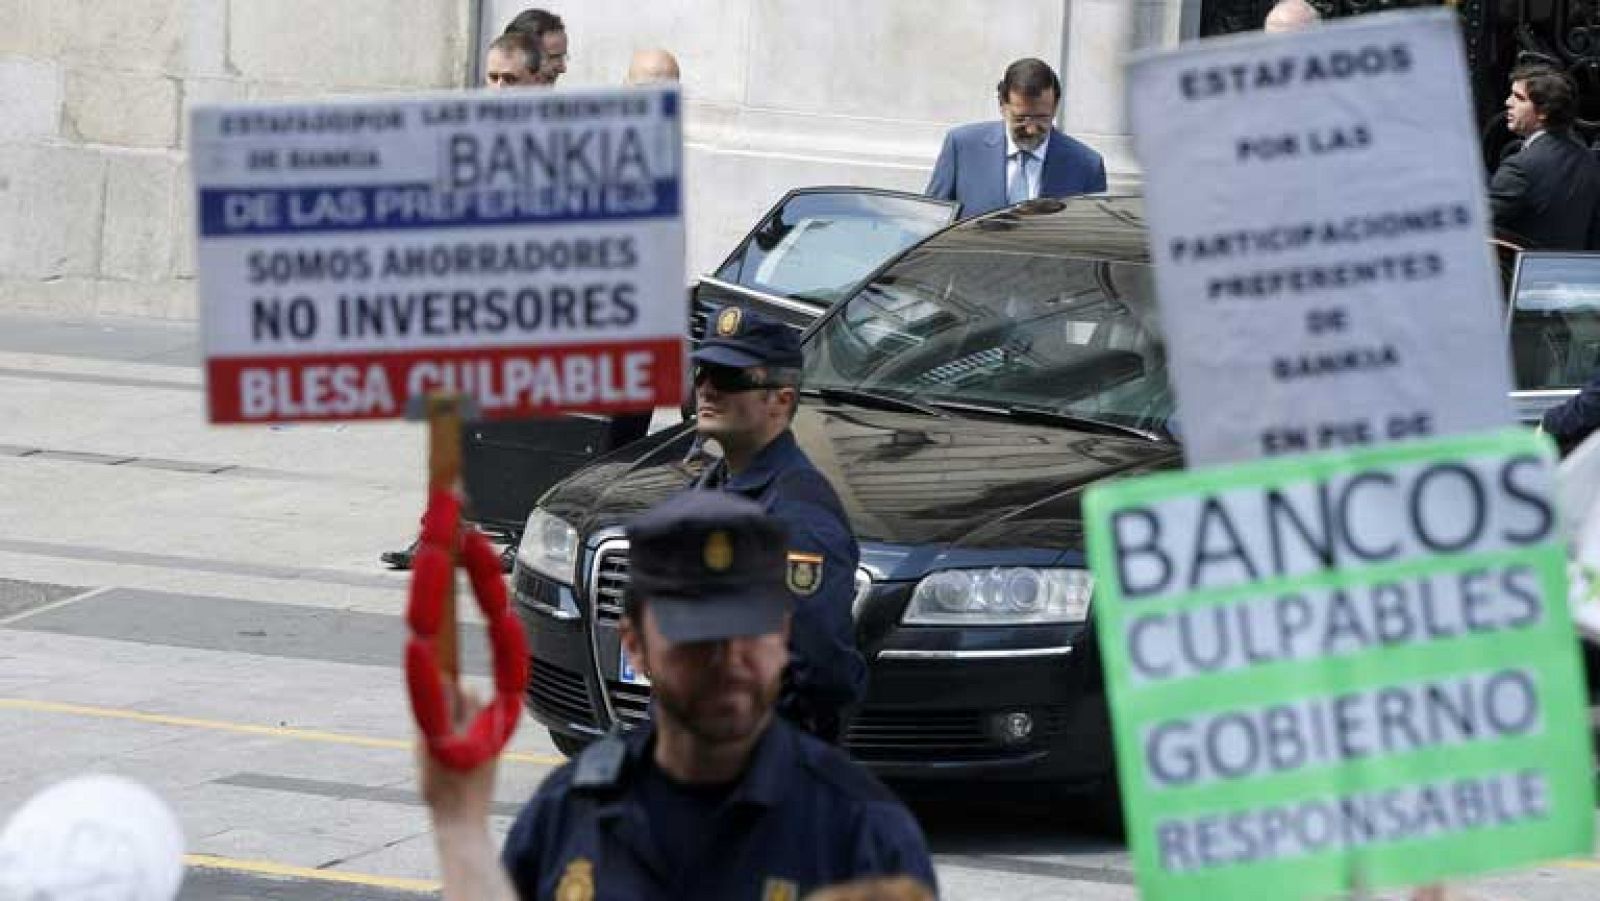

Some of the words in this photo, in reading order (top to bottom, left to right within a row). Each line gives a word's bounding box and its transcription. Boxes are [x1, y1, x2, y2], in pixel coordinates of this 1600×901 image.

[1179, 43, 1412, 100] ESTAFADOS
[421, 100, 469, 126] LAS
[246, 148, 280, 171] DE
[287, 147, 381, 171] BANKIA
[450, 126, 653, 190] BANKIA
[1236, 131, 1298, 161] POR
[1308, 123, 1373, 155] LAS
[223, 193, 279, 228] DE
[289, 188, 368, 225] LAS
[1169, 204, 1471, 261] PARTICIPACIONES
[247, 249, 372, 285] SOMOS
[381, 237, 639, 280] AHORRADORES
[1206, 252, 1444, 299] PREFERENTES
[252, 296, 317, 342] NO
[338, 283, 640, 340] INVERSORES
[1305, 309, 1348, 335] DE
[239, 363, 396, 419] BLESA
[407, 351, 656, 408] CULPABLE
[1272, 345, 1398, 381] BANKIA
[1261, 429, 1308, 453] EN
[1109, 454, 1556, 598] BANCOS
[1127, 565, 1543, 677] CULPABLES
[1144, 669, 1540, 786] GOBIERNO
[1156, 770, 1550, 873] RESPONSABLE
